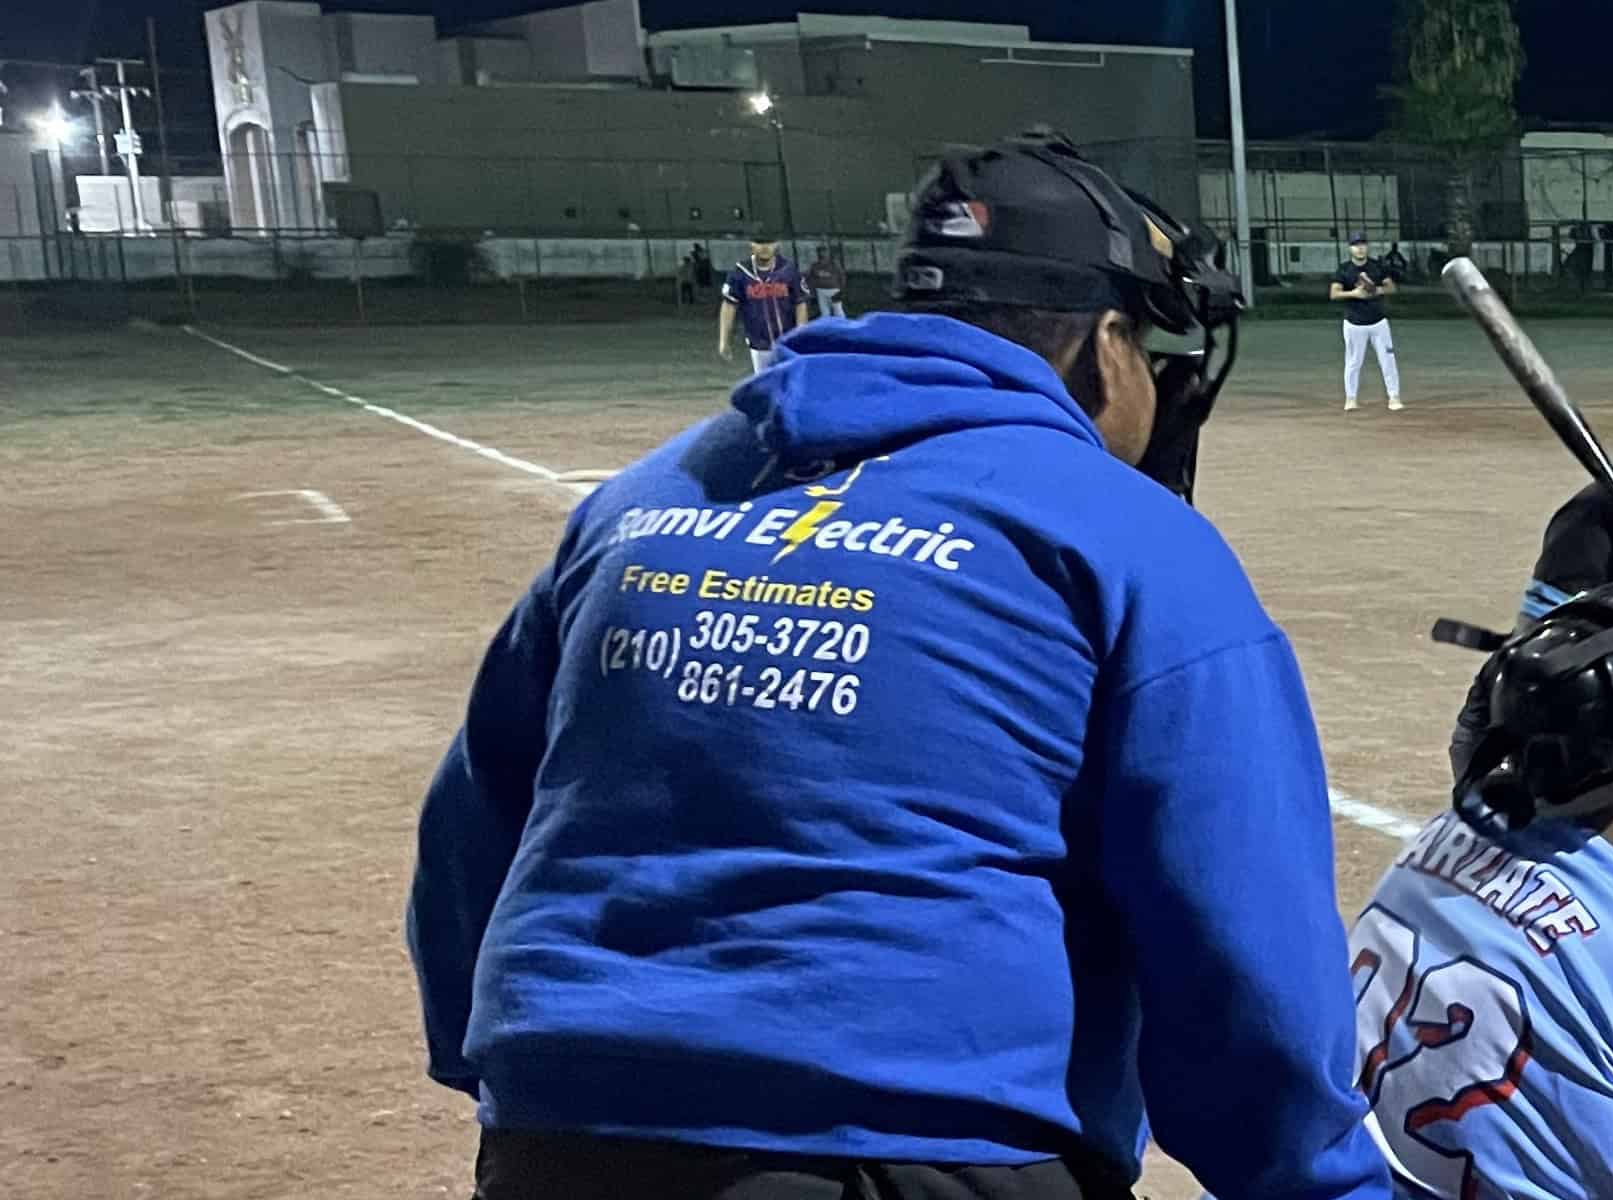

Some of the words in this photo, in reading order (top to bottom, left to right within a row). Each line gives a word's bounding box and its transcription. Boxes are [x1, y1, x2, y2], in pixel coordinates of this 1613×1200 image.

[621, 566, 690, 595] Free
[699, 570, 875, 611] Estimates
[601, 627, 681, 678] (210)
[689, 611, 870, 663] 305-3720
[678, 661, 860, 714] 861-2476
